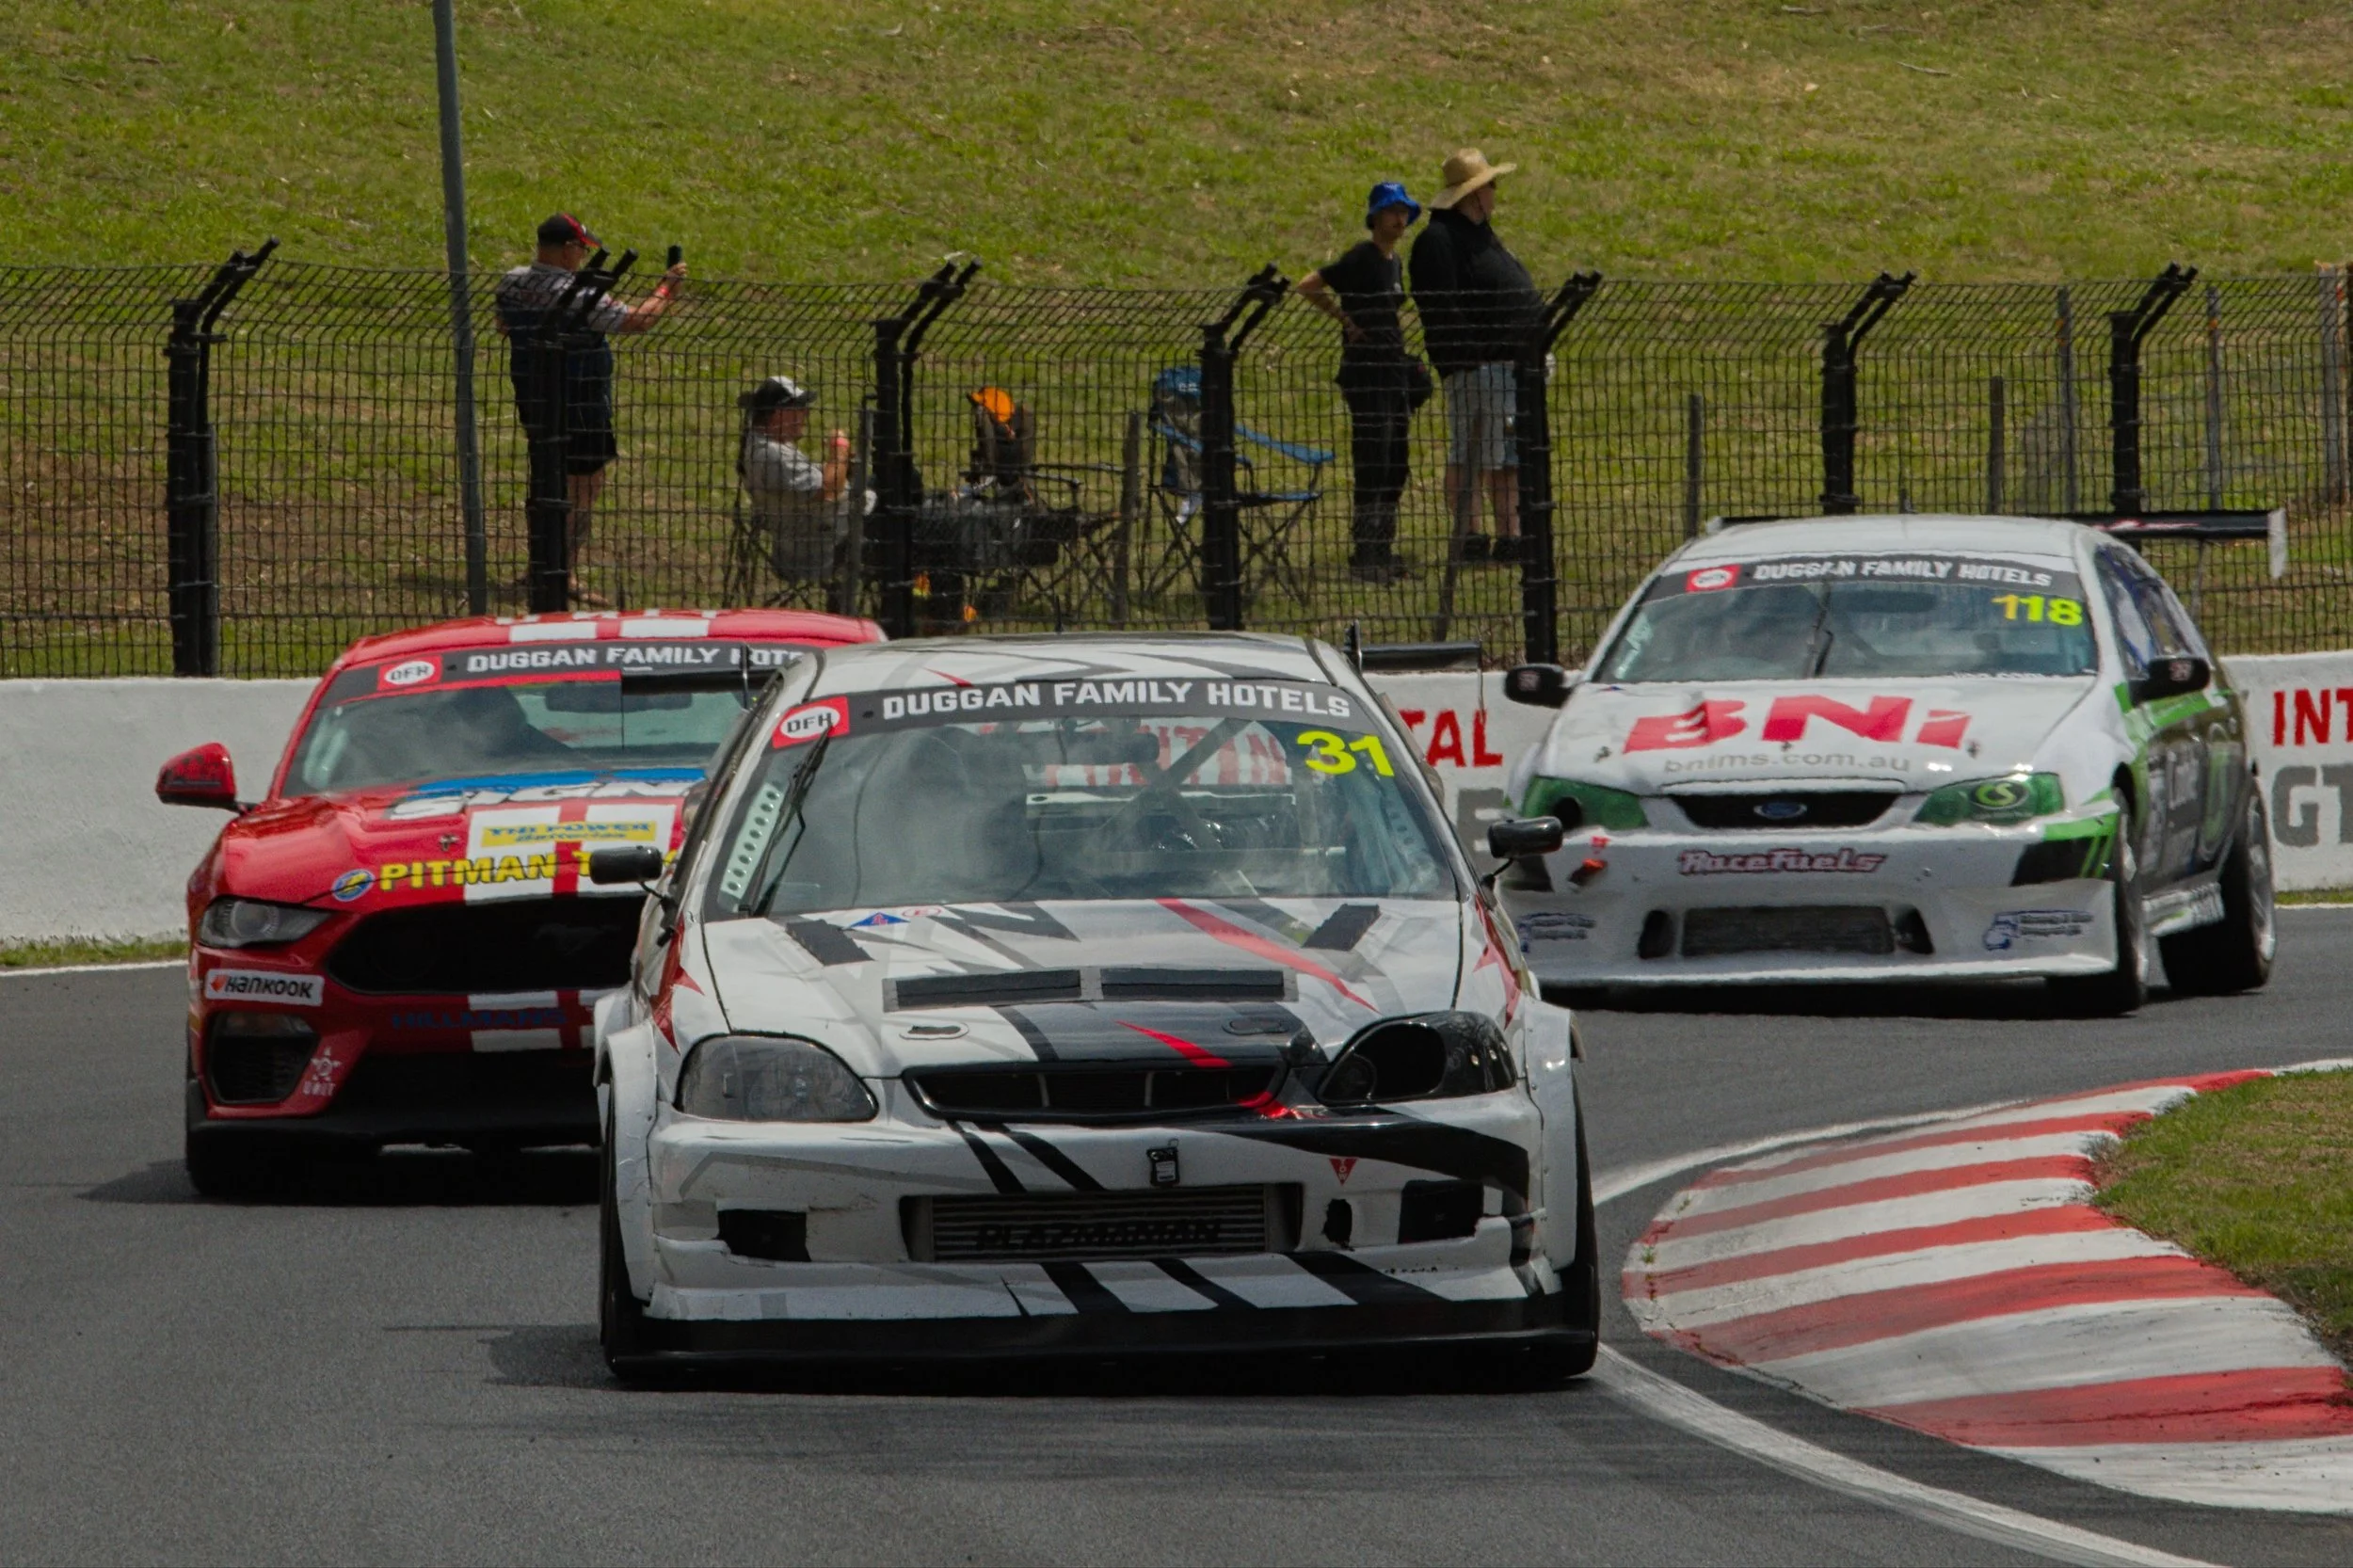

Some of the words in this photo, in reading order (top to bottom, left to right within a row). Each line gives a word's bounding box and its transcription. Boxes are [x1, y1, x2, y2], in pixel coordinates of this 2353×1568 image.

[1753, 561, 1856, 580] DUGGAN
[1862, 560, 1953, 579] FAMILY
[1958, 563, 2053, 587] HOTELS
[1991, 594, 2083, 626] 118
[467, 647, 597, 673] DUGGAN
[606, 647, 721, 664] FAMILY
[883, 683, 1040, 721] DUGGAN
[1054, 680, 1193, 706] FAMILY
[1208, 683, 1351, 718] HOTELS
[786, 712, 833, 734] DFH
[1296, 730, 1395, 777] 31
[1663, 754, 1911, 774] bnims.com.au
[380, 853, 559, 891] PITMAN
